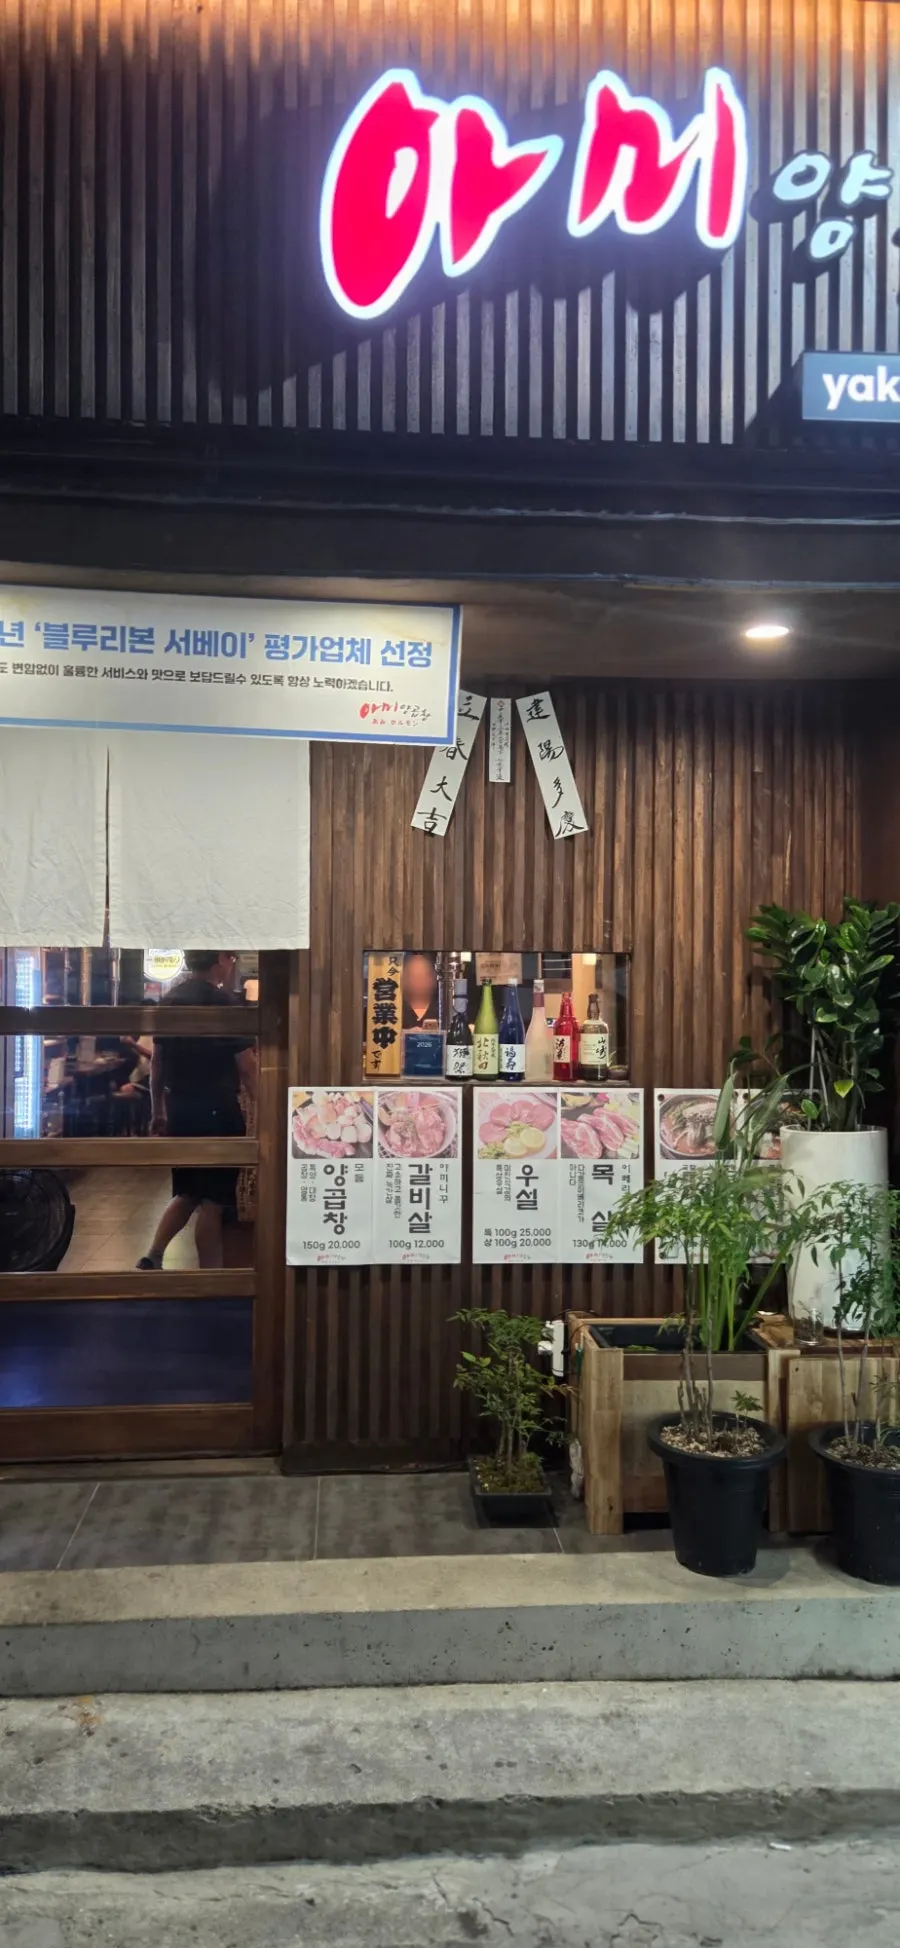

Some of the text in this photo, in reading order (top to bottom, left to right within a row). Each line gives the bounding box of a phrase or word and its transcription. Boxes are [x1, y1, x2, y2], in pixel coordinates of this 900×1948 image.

[323, 70, 746, 318] 아미
[822, 365, 900, 411] yak
[0, 621, 25, 648] 년
[264, 634, 372, 665] 평가업체
[380, 641, 432, 668] 선정
[12, 662, 60, 676] 변함없이
[63, 665, 98, 678] 훌륭한
[101, 667, 148, 681] 서비스와
[151, 669, 186, 683] 맛으로
[190, 671, 246, 685] 보답드릴수
[250, 673, 284, 687] 있도록
[287, 675, 310, 688] 항상
[313, 677, 394, 692] 노력하겠습니다.
[372, 977, 399, 1050] 営業中
[370, 1050, 383, 1072] です
[323, 1163, 348, 1235] 양곱창
[408, 1163, 433, 1234] 갈비살
[515, 1164, 539, 1211] 우설
[302, 1240, 326, 1252] 150g
[388, 1239, 412, 1250] 100g
[484, 1238, 492, 1247] 상
[494, 1238, 517, 1249] 100g
[494, 1228, 517, 1239] 100g
